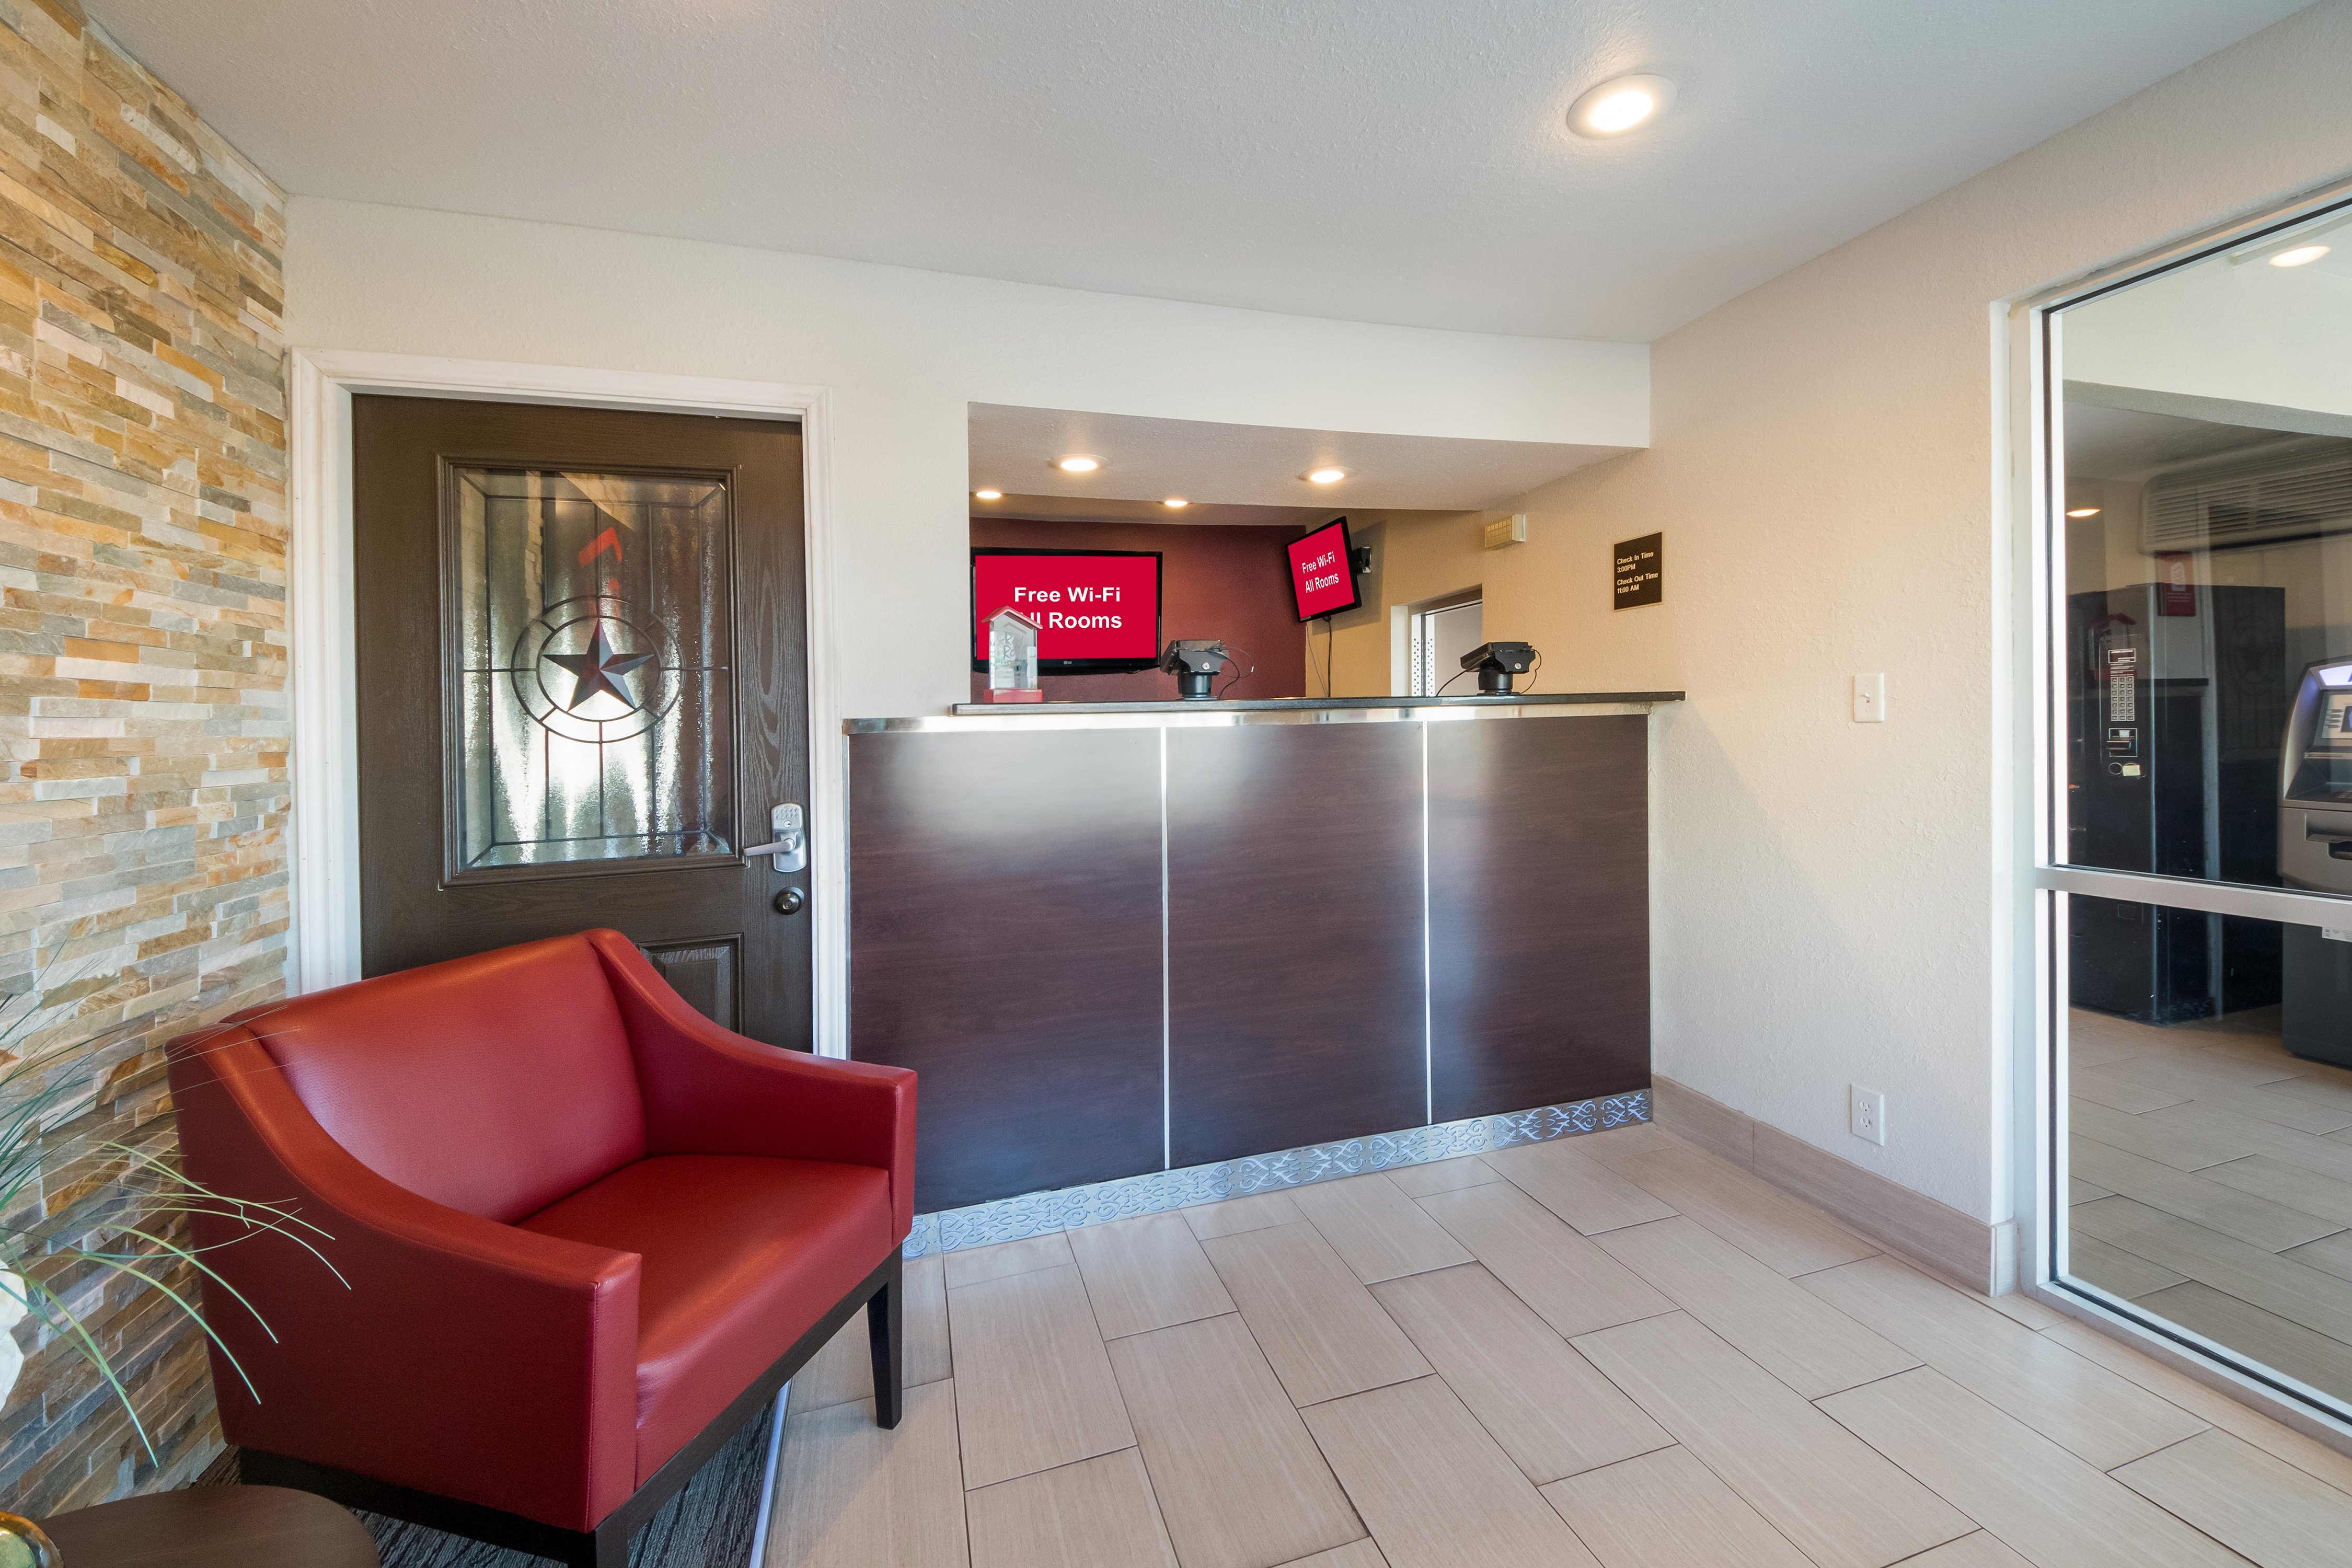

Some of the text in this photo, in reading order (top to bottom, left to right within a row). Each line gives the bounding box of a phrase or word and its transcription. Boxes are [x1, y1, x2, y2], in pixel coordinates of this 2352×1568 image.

[1302, 551, 1335, 573] Free Wi-Fi
[1617, 556, 1632, 564] Check
[1617, 563, 1635, 573] 3:00PM
[1306, 573, 1339, 593] All Rooms
[1617, 577, 1633, 585] Check
[1014, 587, 1120, 602] Free Wi-Fi
[1049, 612, 1122, 628] Rooms
